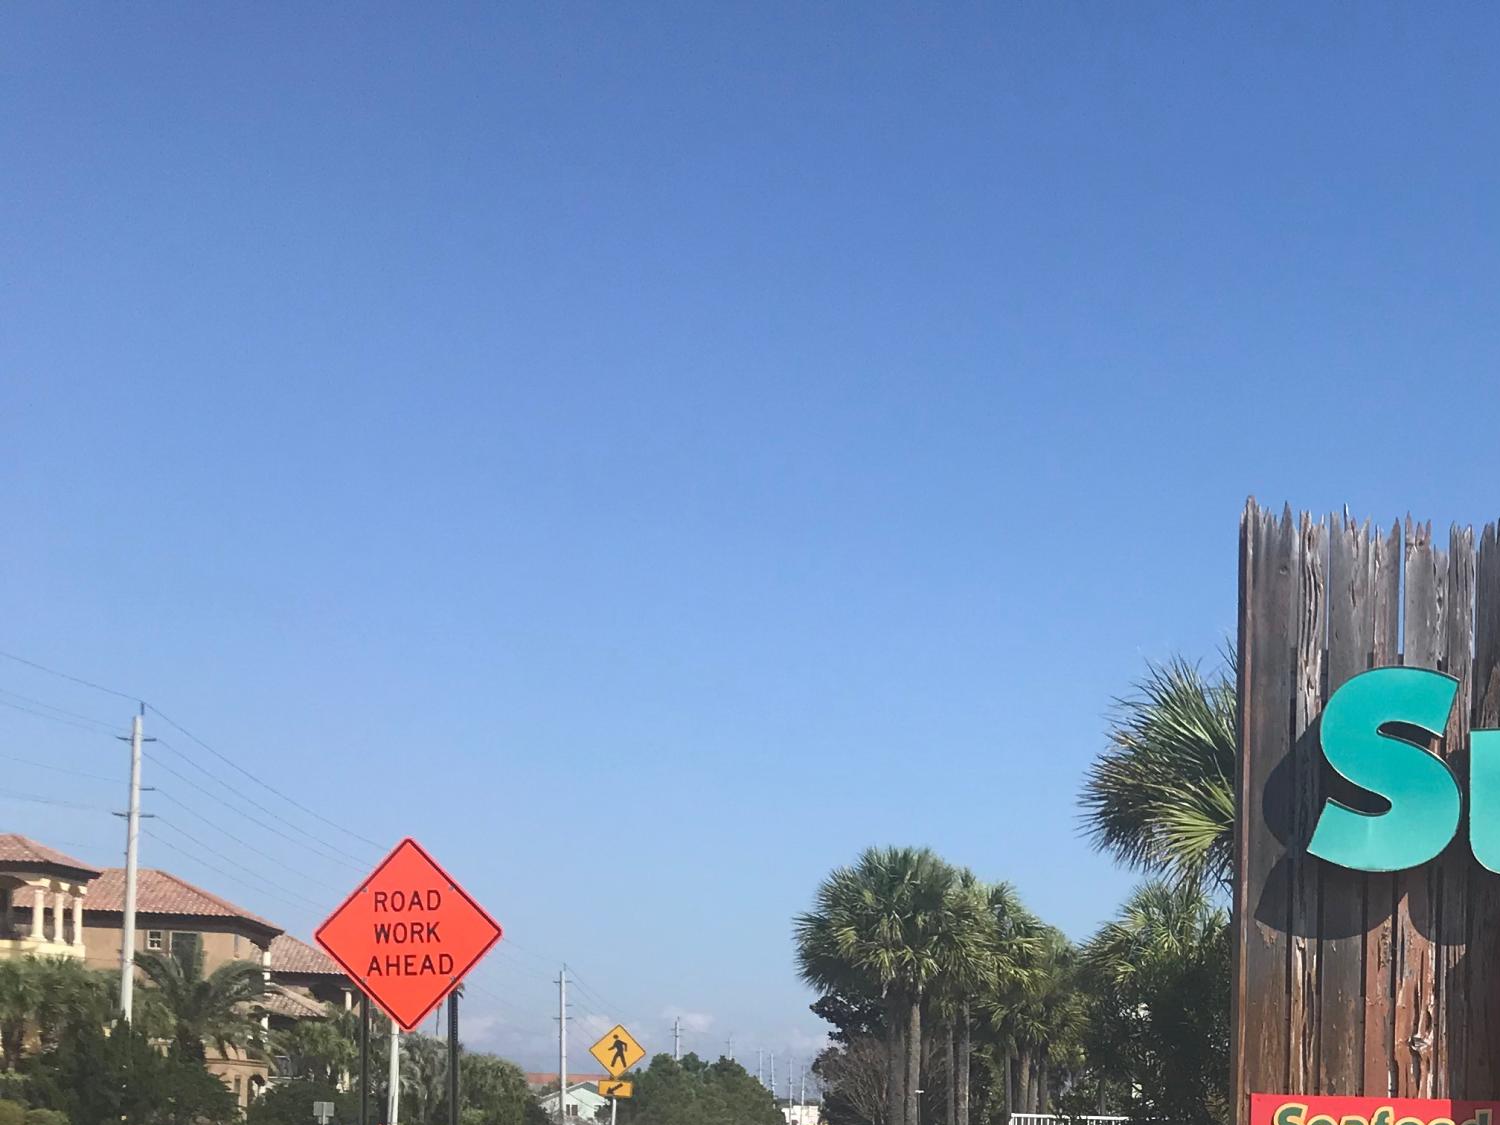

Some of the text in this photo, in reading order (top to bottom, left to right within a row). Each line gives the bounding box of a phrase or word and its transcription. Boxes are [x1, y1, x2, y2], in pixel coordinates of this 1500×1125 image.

[374, 890, 441, 912] ROAD
[374, 922, 441, 944] WORK
[366, 953, 454, 977] AHEAD
